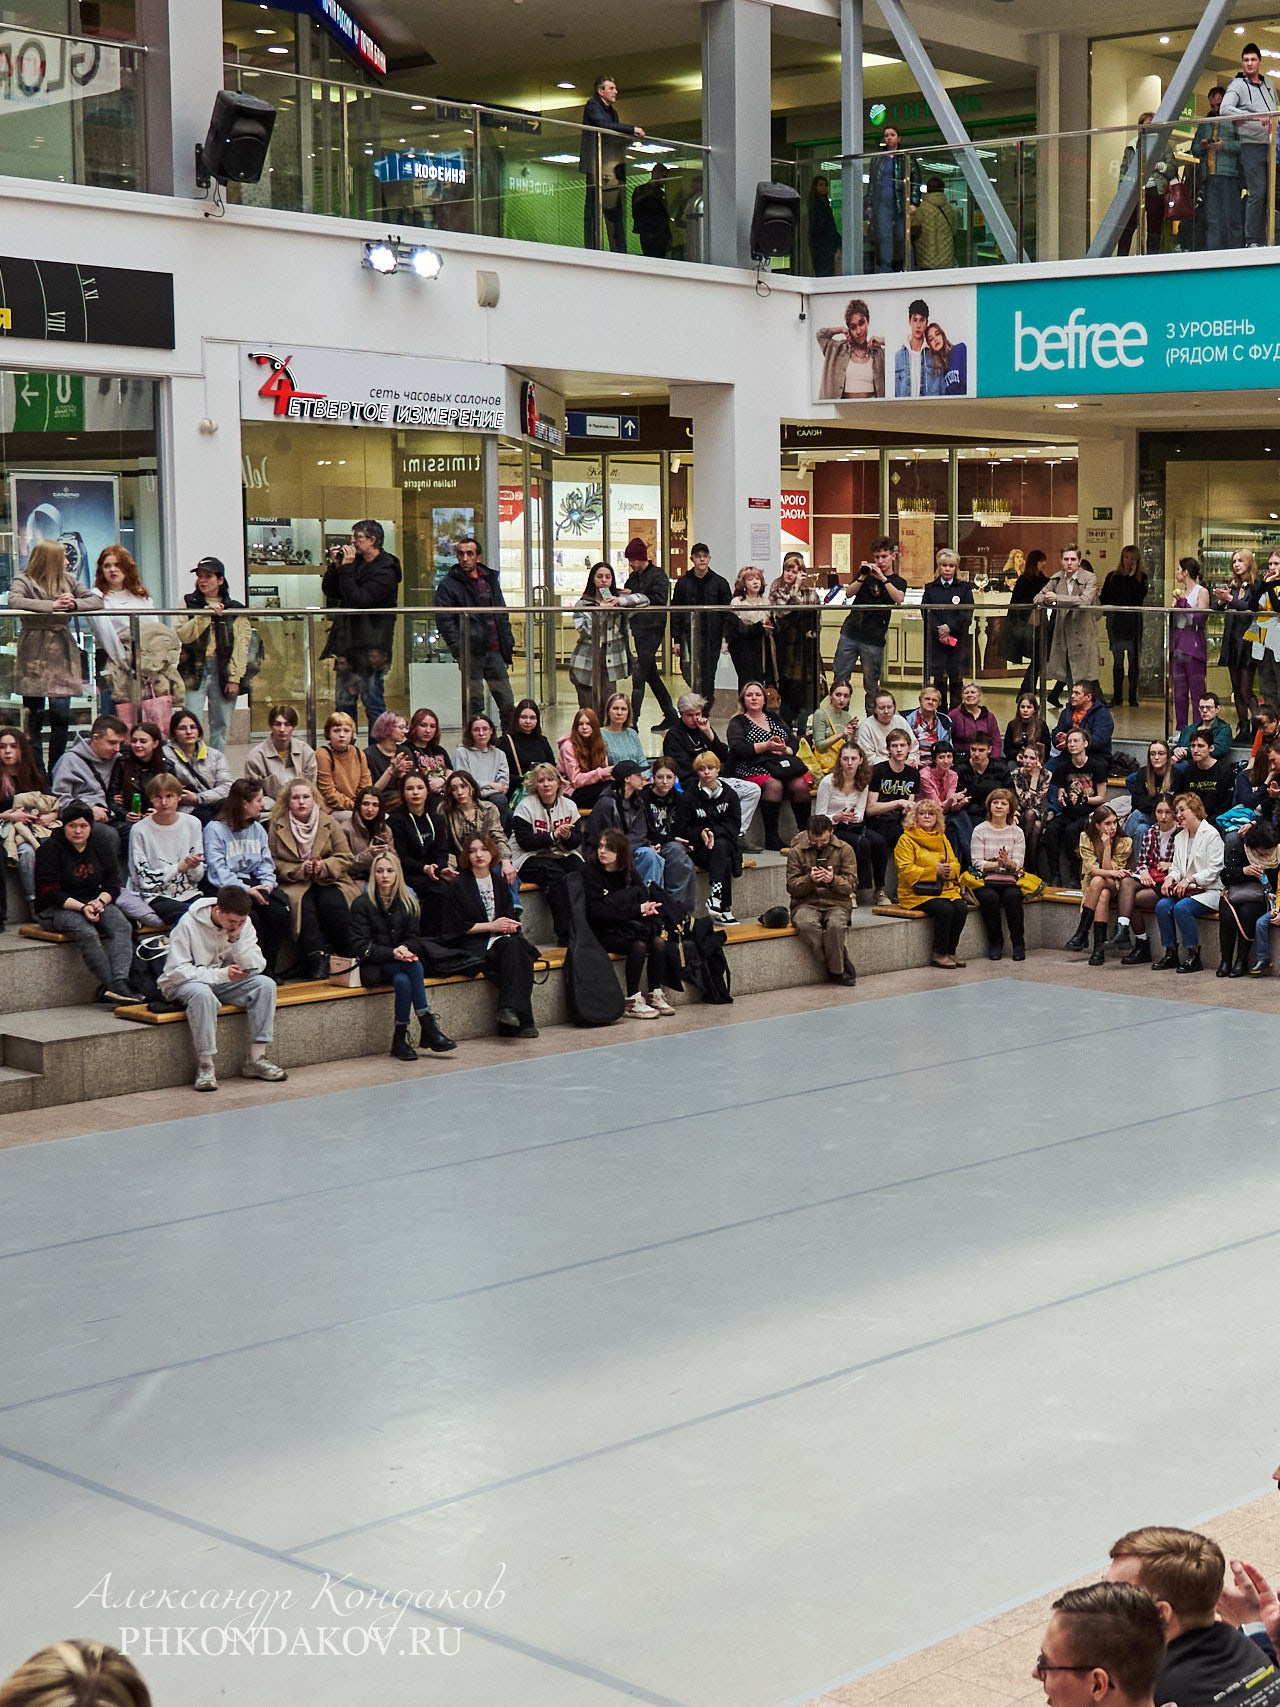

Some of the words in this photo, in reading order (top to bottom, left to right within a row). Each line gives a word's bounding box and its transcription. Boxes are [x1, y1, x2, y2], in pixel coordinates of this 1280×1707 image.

[1166, 323, 1176, 339] 3
[1179, 318, 1255, 339] УРОВЕНЬ
[1014, 307, 1148, 373] befree
[1165, 344, 1228, 368] (РЯДОМ
[1232, 345, 1244, 361] С
[369, 388, 400, 401] сеть
[403, 389, 452, 405] часовых
[454, 392, 501, 407] салонов
[394, 404, 506, 429] ИЗМЕРЕНИЕ
[796, 429, 822, 437] САЛОН
